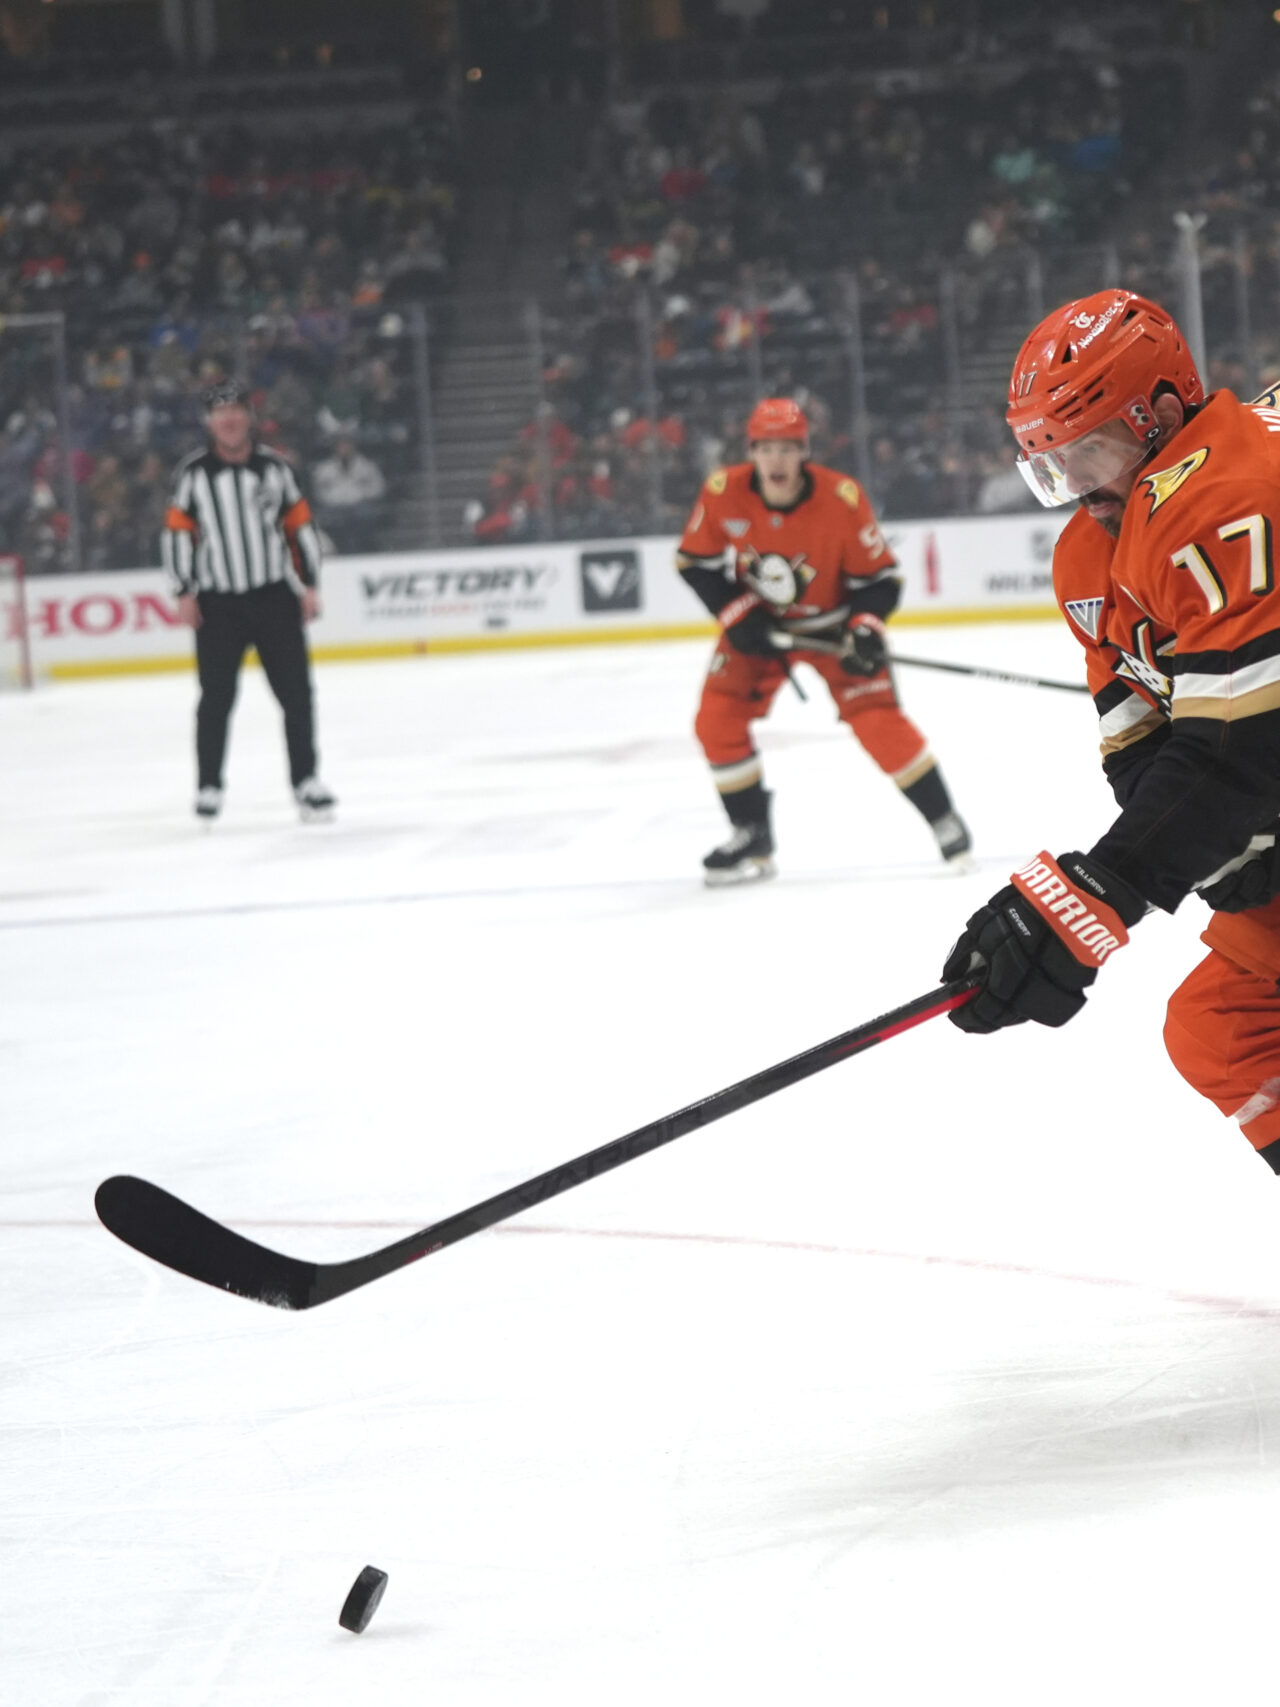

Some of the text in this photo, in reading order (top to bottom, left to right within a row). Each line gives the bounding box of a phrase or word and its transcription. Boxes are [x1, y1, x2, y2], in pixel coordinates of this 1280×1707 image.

[1019, 370, 1038, 398] 17
[1015, 416, 1045, 434] BAUER
[1170, 513, 1274, 615] 17
[359, 564, 549, 599] VICTORY
[1073, 864, 1106, 895] KILLORN
[1008, 907, 1032, 937] COVERT
[1018, 857, 1120, 961] ARRIOR
